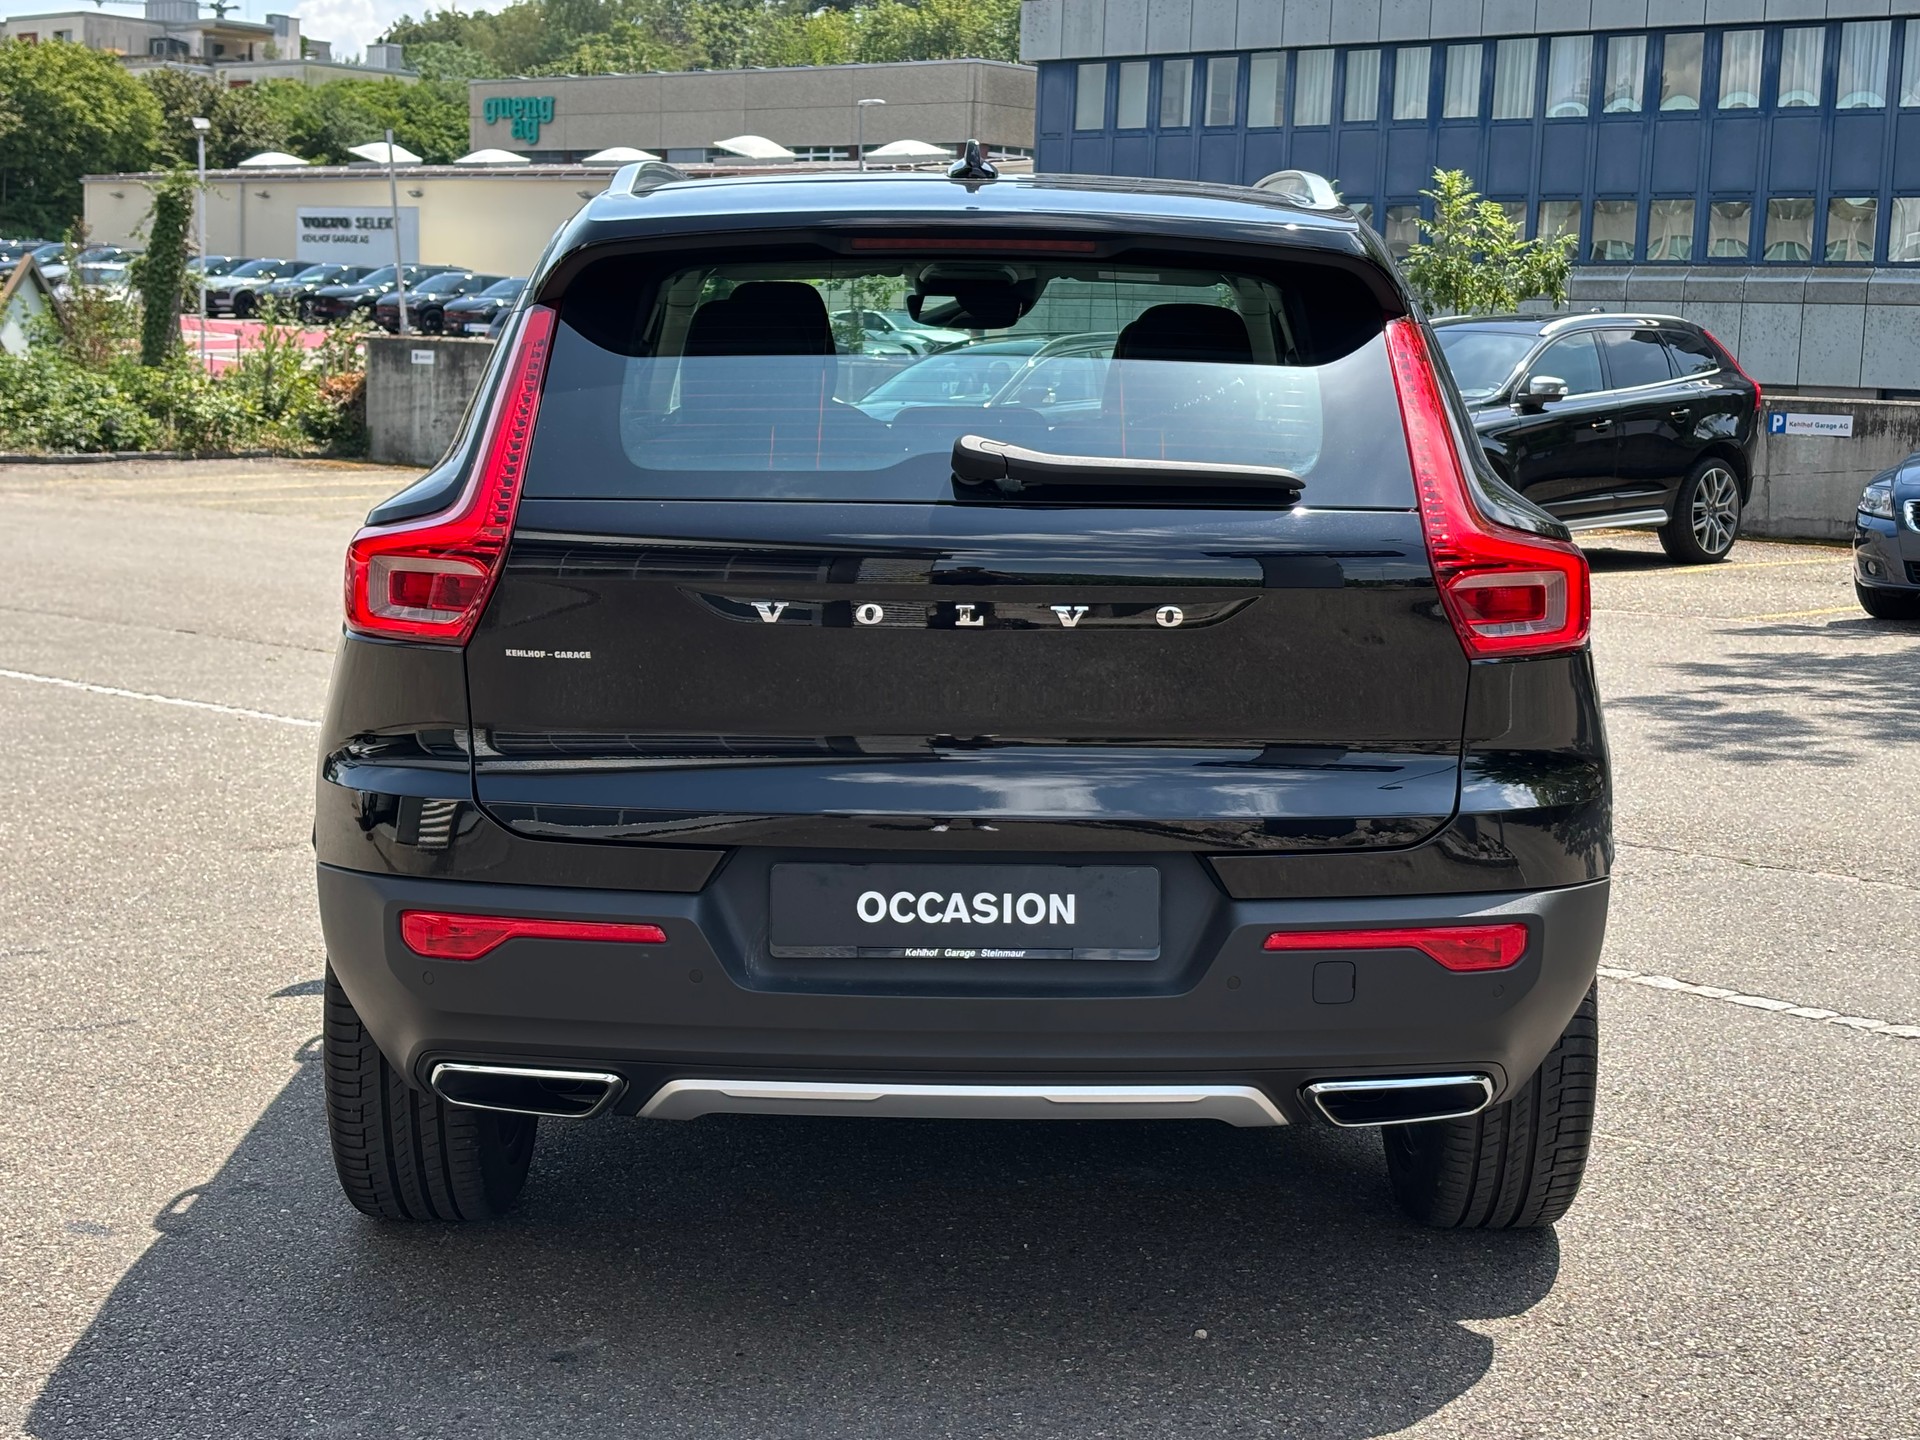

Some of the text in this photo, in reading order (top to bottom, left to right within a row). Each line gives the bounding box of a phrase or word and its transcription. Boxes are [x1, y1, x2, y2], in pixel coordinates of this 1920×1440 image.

[484, 96, 555, 125] gueng
[511, 118, 540, 146] ag
[301, 216, 401, 230] VOLVO SELEK
[332, 234, 359, 244] GARAGE
[360, 235, 369, 244] AG
[1772, 414, 1784, 432] P
[1789, 421, 1813, 429] Kehlhof
[1815, 422, 1837, 431] Garage
[751, 601, 1184, 628] VOLVO
[505, 649, 546, 658] KEHLHOF
[554, 651, 591, 659] GARAGE
[856, 891, 1076, 925] OCCASION
[905, 948, 1025, 959] Kehlhof Garage Steinmaur
